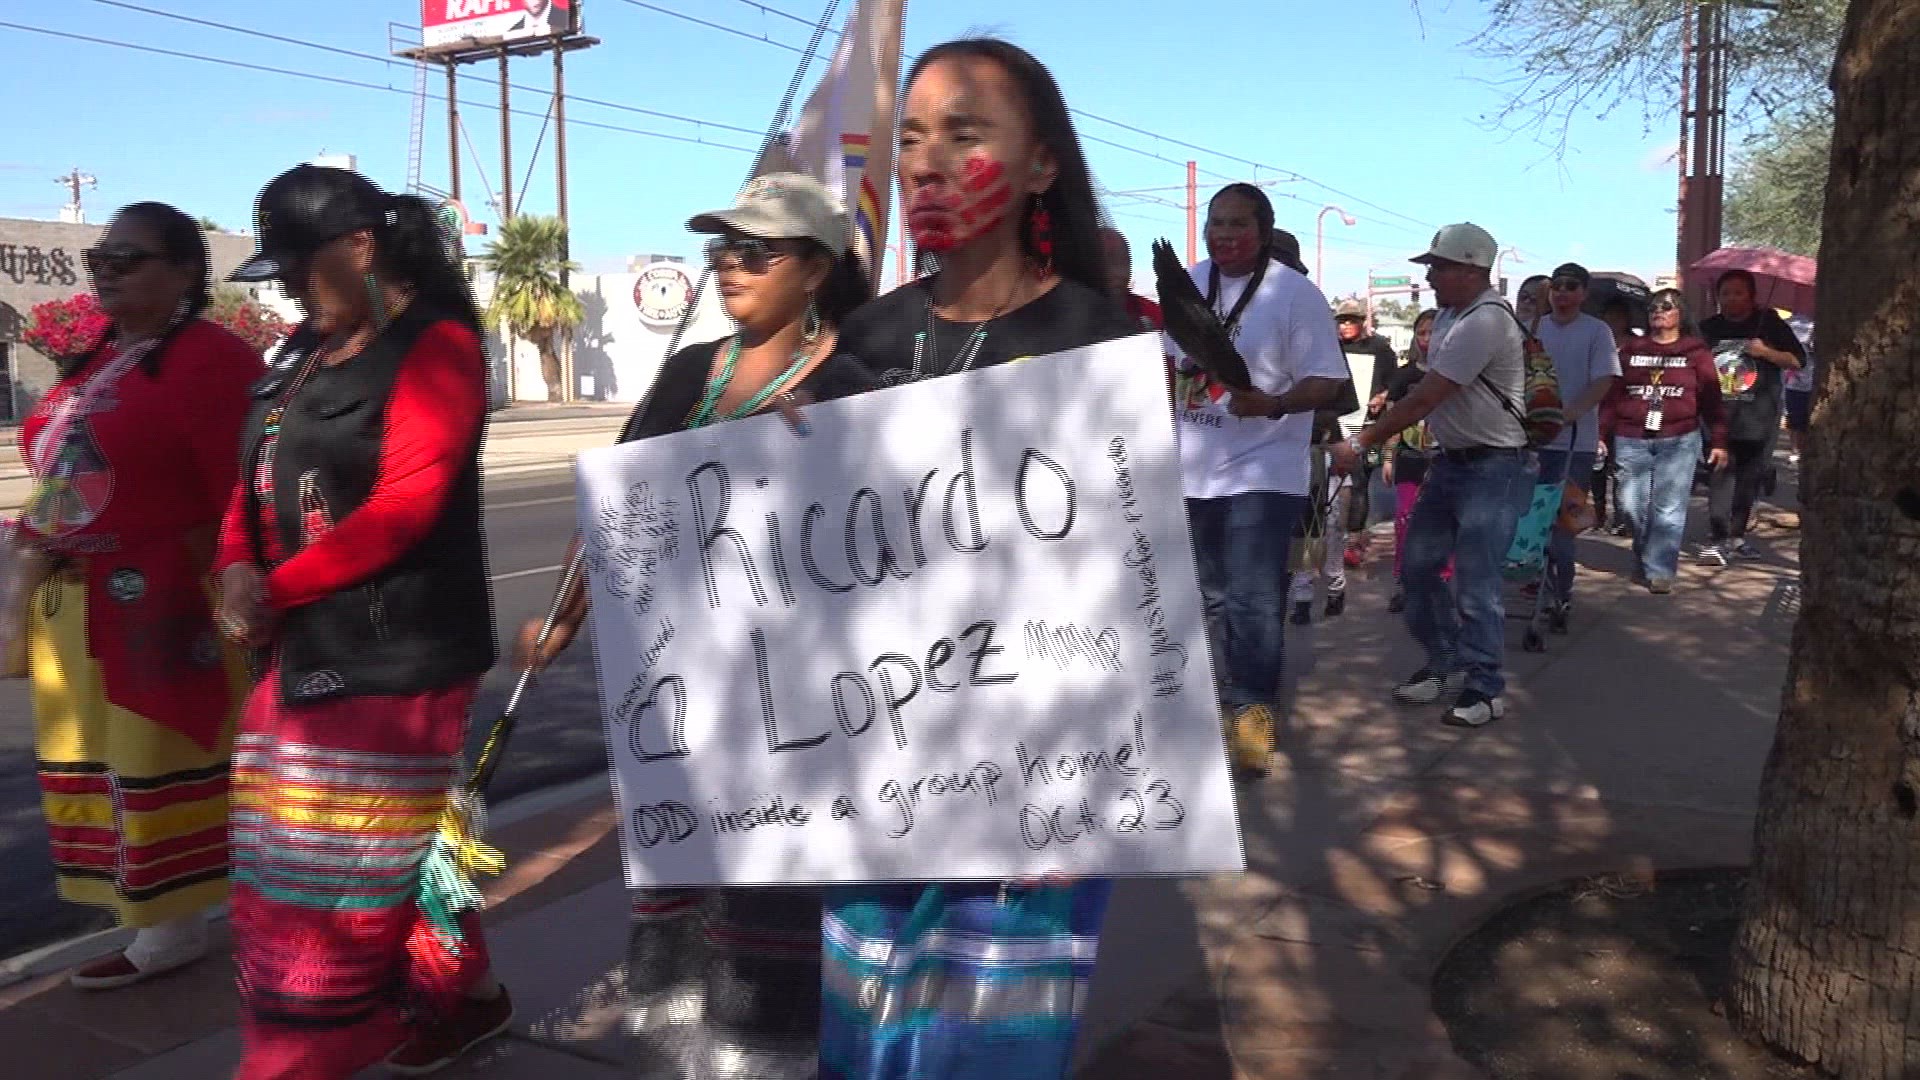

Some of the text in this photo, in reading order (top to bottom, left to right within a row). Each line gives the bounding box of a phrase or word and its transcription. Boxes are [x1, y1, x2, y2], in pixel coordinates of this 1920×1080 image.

[1644, 384, 1684, 397] DVILS
[686, 427, 1077, 609] Ricardo
[750, 618, 1123, 753] Lopez MMIP
[632, 711, 1150, 849] OD inside a group home!
[1116, 779, 1186, 833] 23
